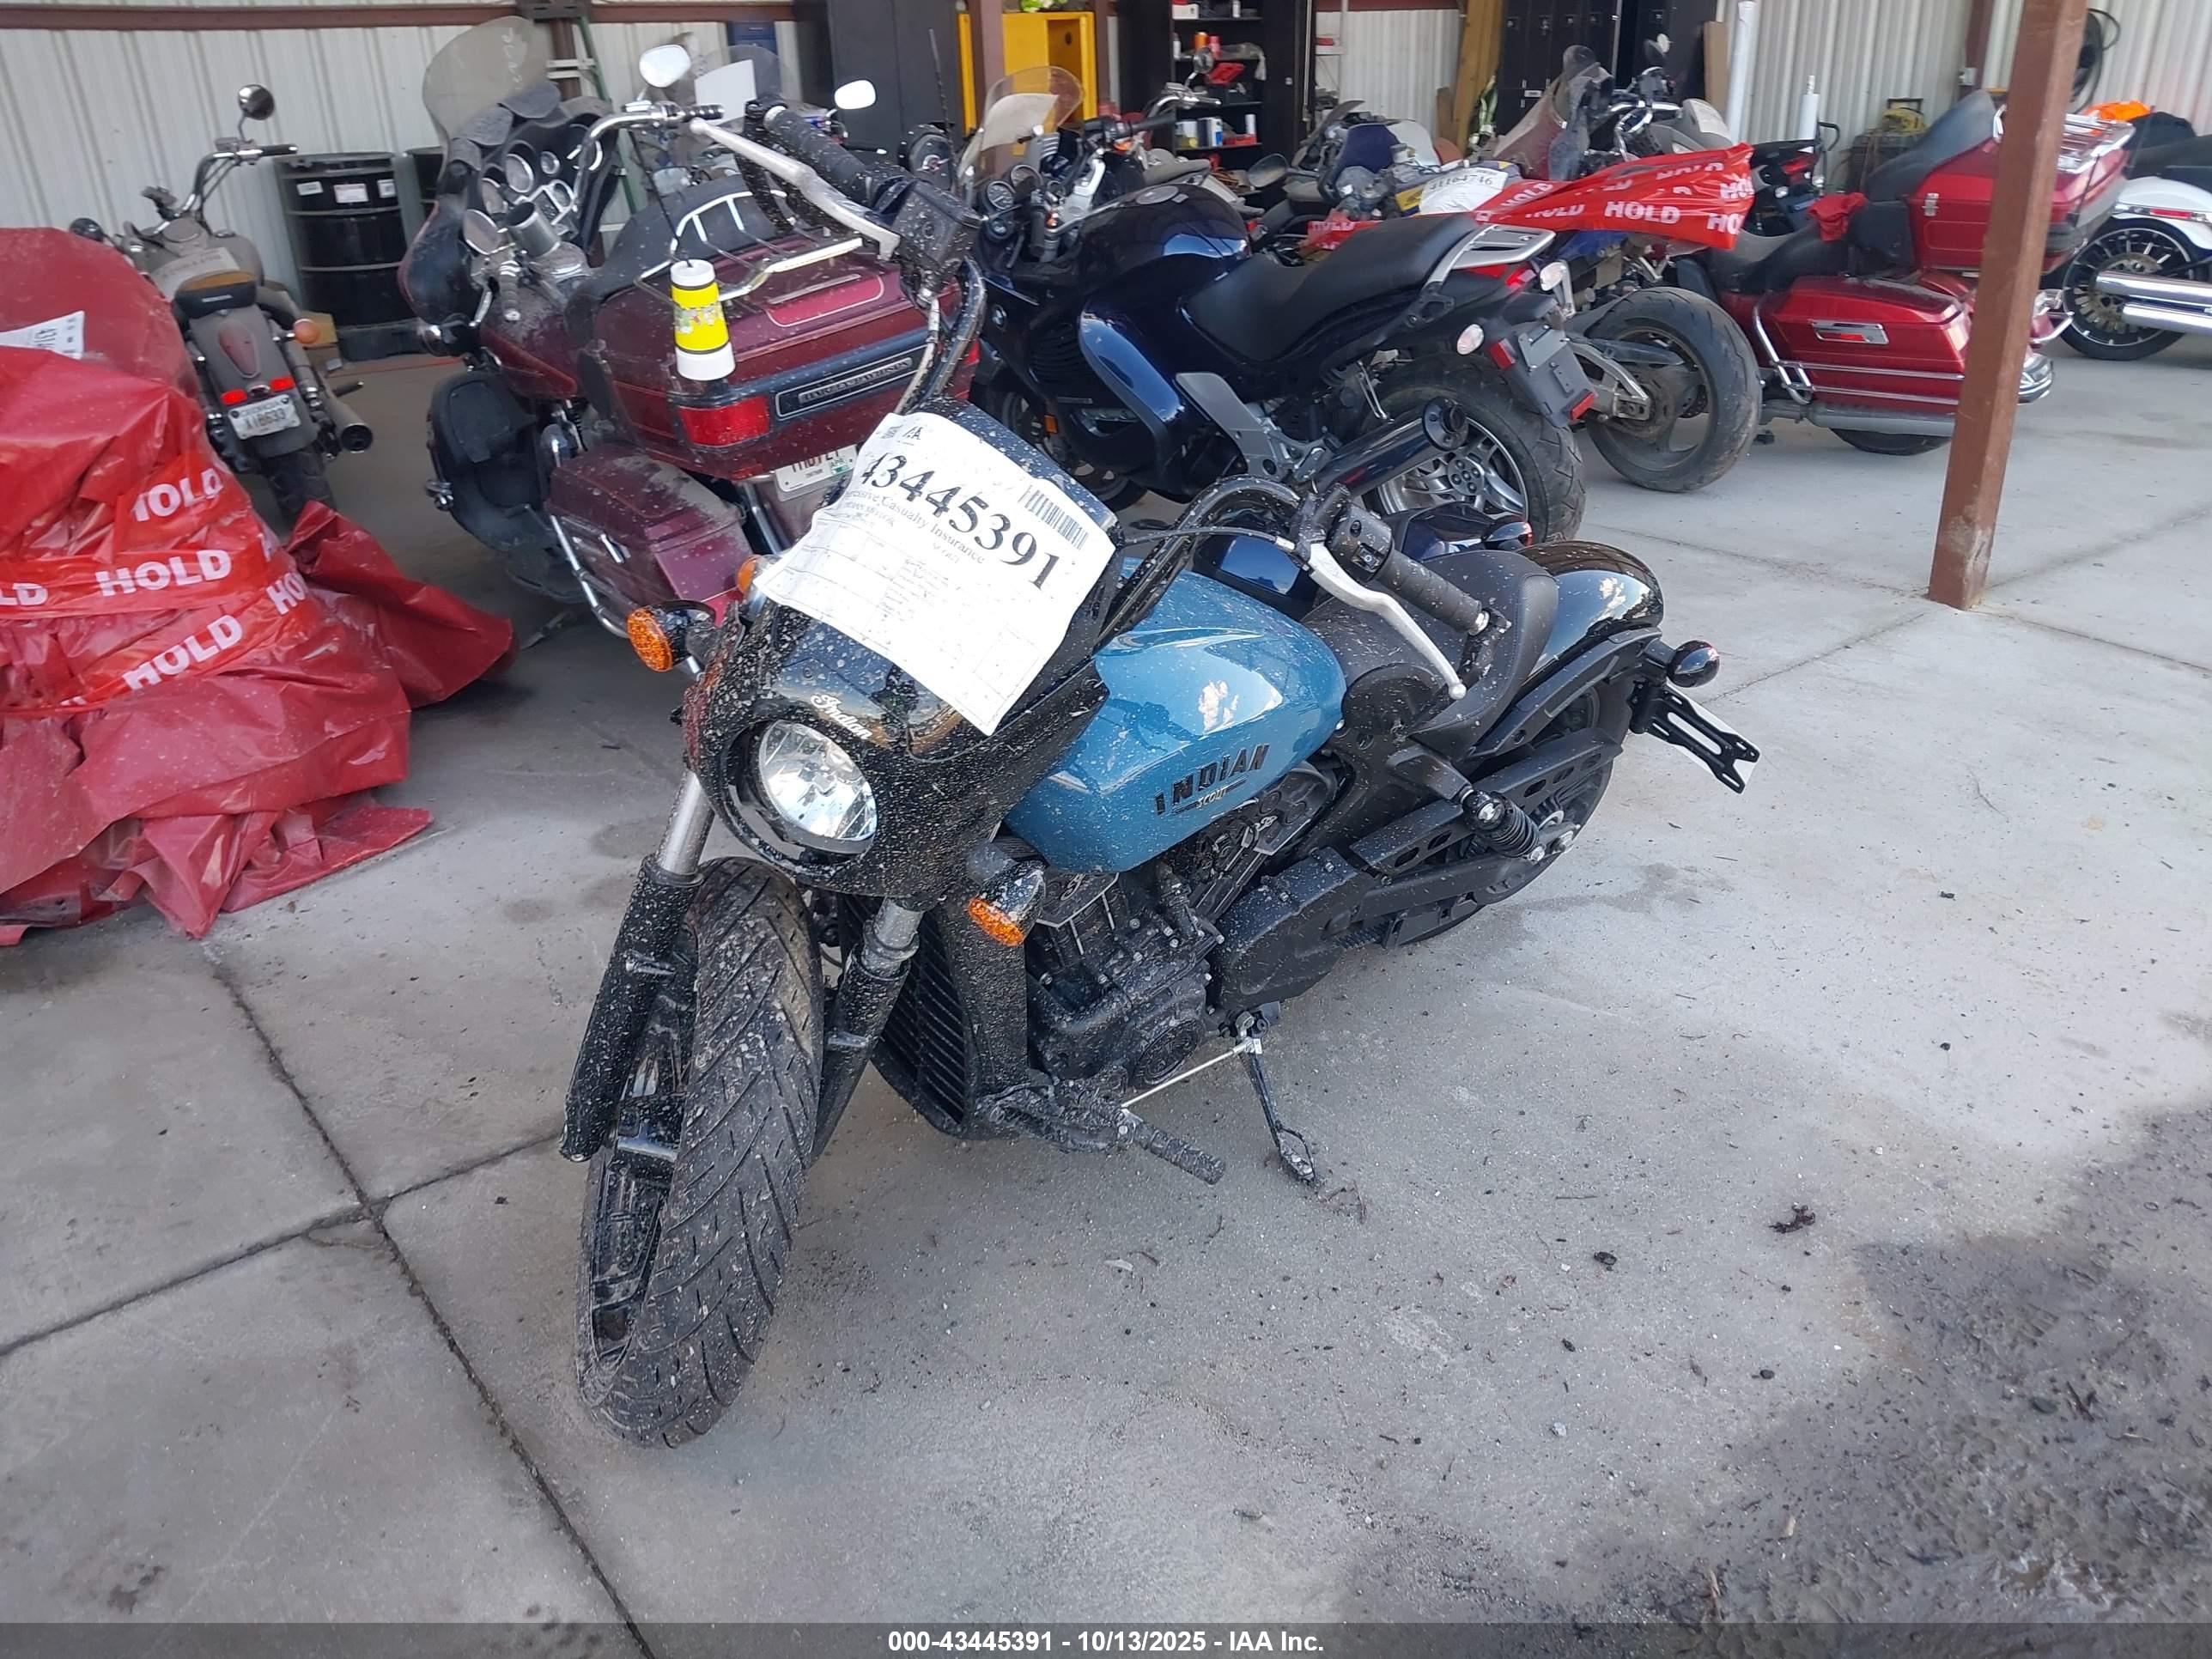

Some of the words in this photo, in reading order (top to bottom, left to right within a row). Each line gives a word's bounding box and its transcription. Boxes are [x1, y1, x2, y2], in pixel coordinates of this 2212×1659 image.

[1604, 201, 1680, 224] HOLD
[882, 495, 928, 529] Casualty
[930, 523, 986, 564] Insurance
[95, 549, 232, 597] HOLD
[123, 615, 243, 690] HOLD
[811, 694, 873, 739] Indian
[1154, 743, 1270, 815] INDIAN
[1195, 787, 1227, 809] SCOUT
